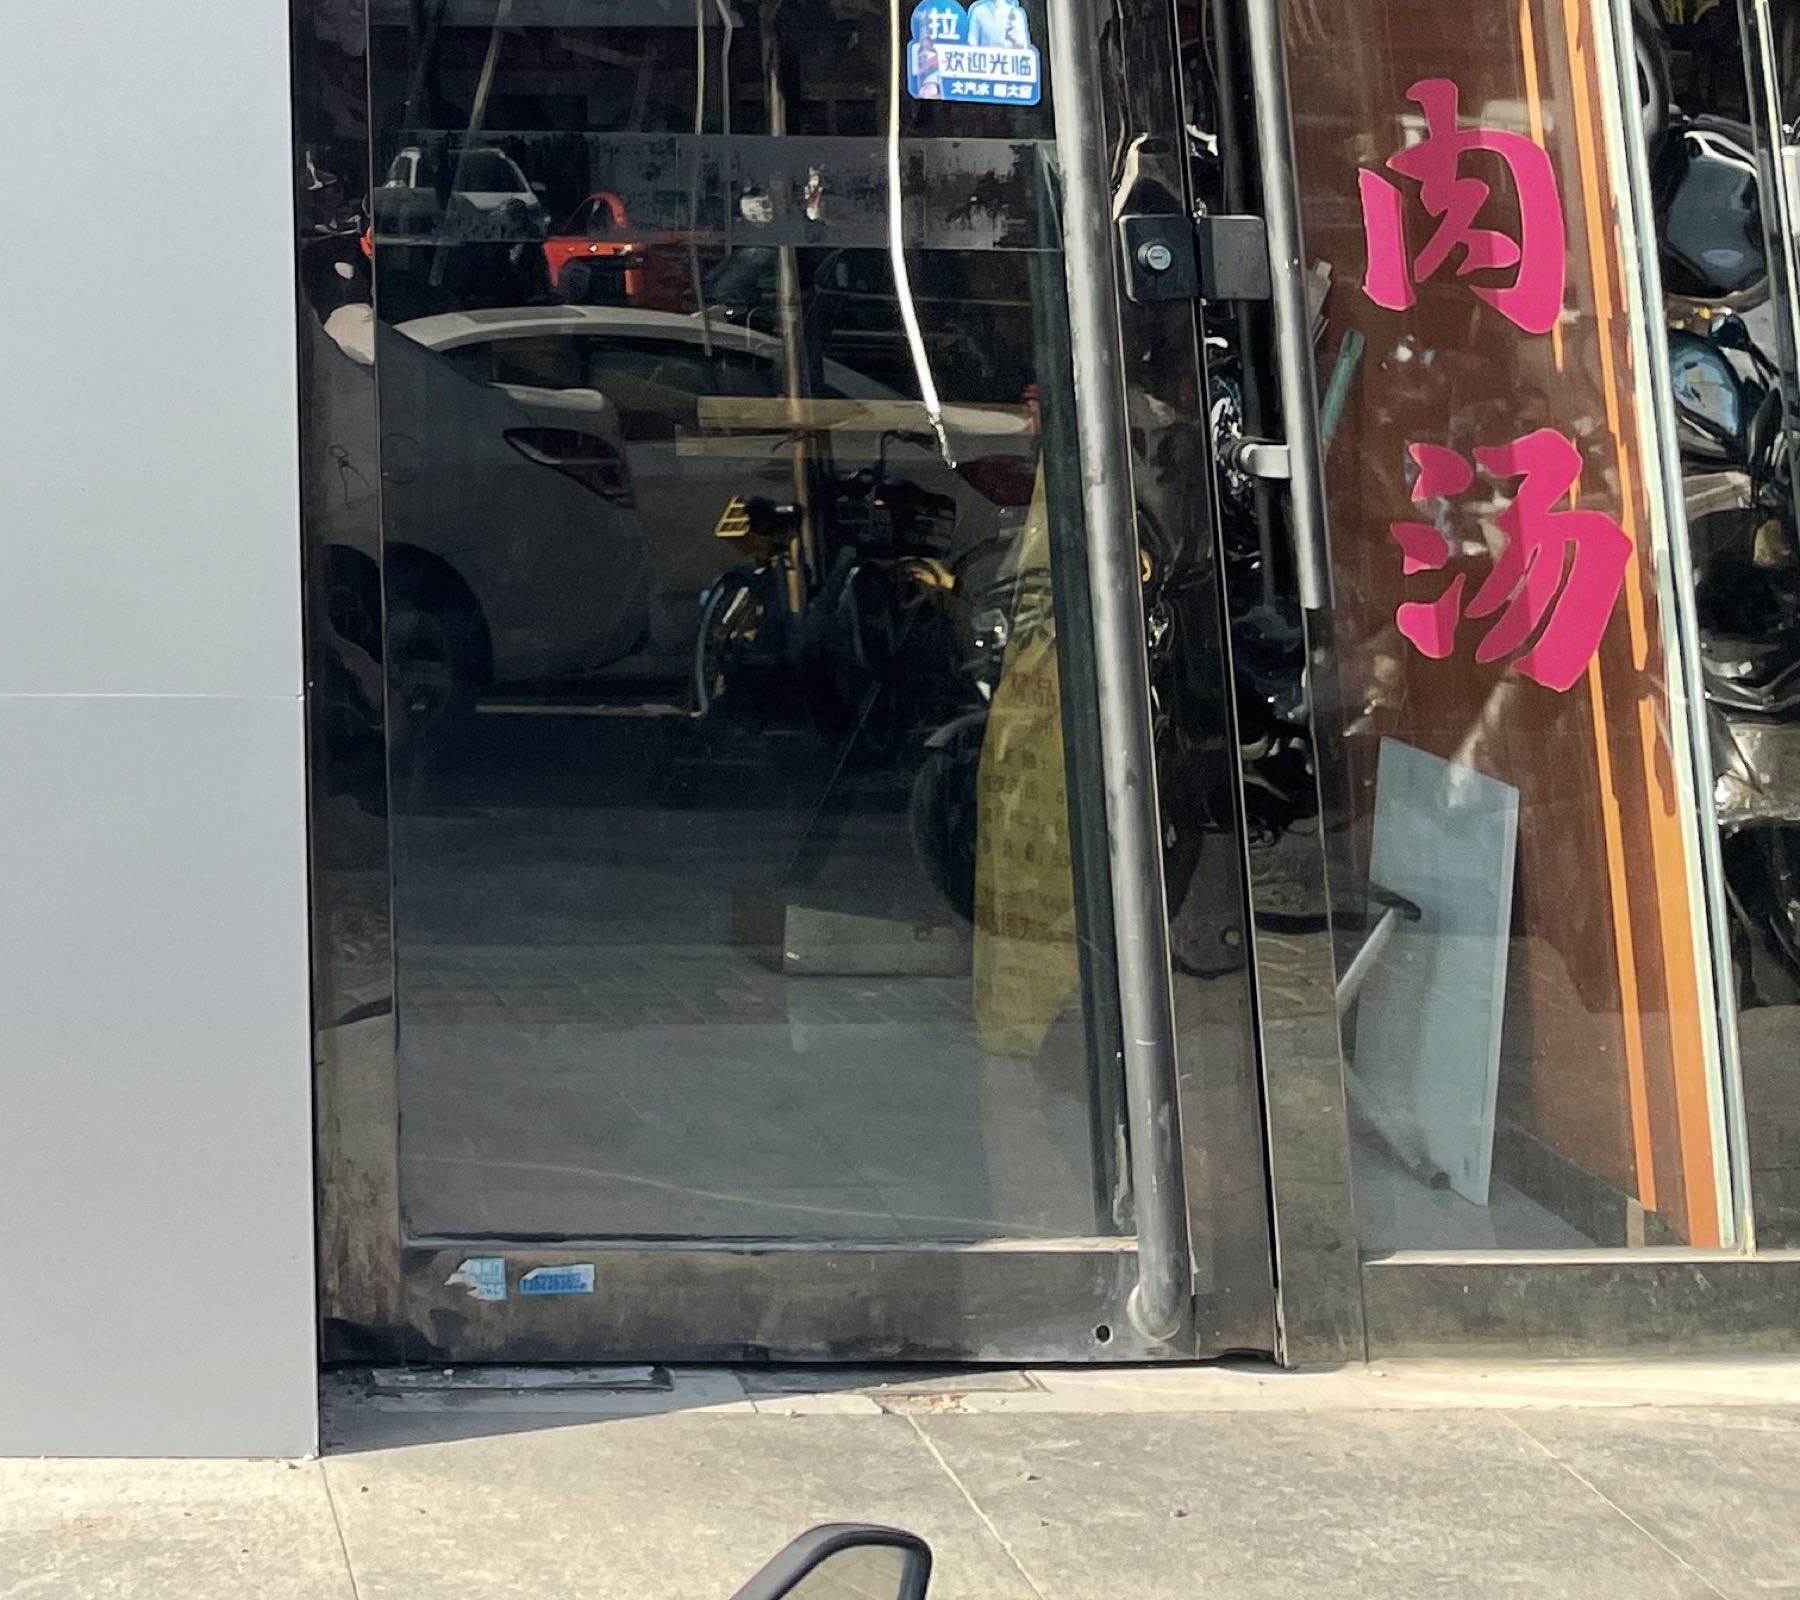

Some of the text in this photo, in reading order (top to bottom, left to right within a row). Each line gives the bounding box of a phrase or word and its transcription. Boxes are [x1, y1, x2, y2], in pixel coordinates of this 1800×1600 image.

[928, 7, 960, 40] 拉
[944, 51, 1032, 76] 欢迎光临
[951, 81, 990, 96] 大汽水
